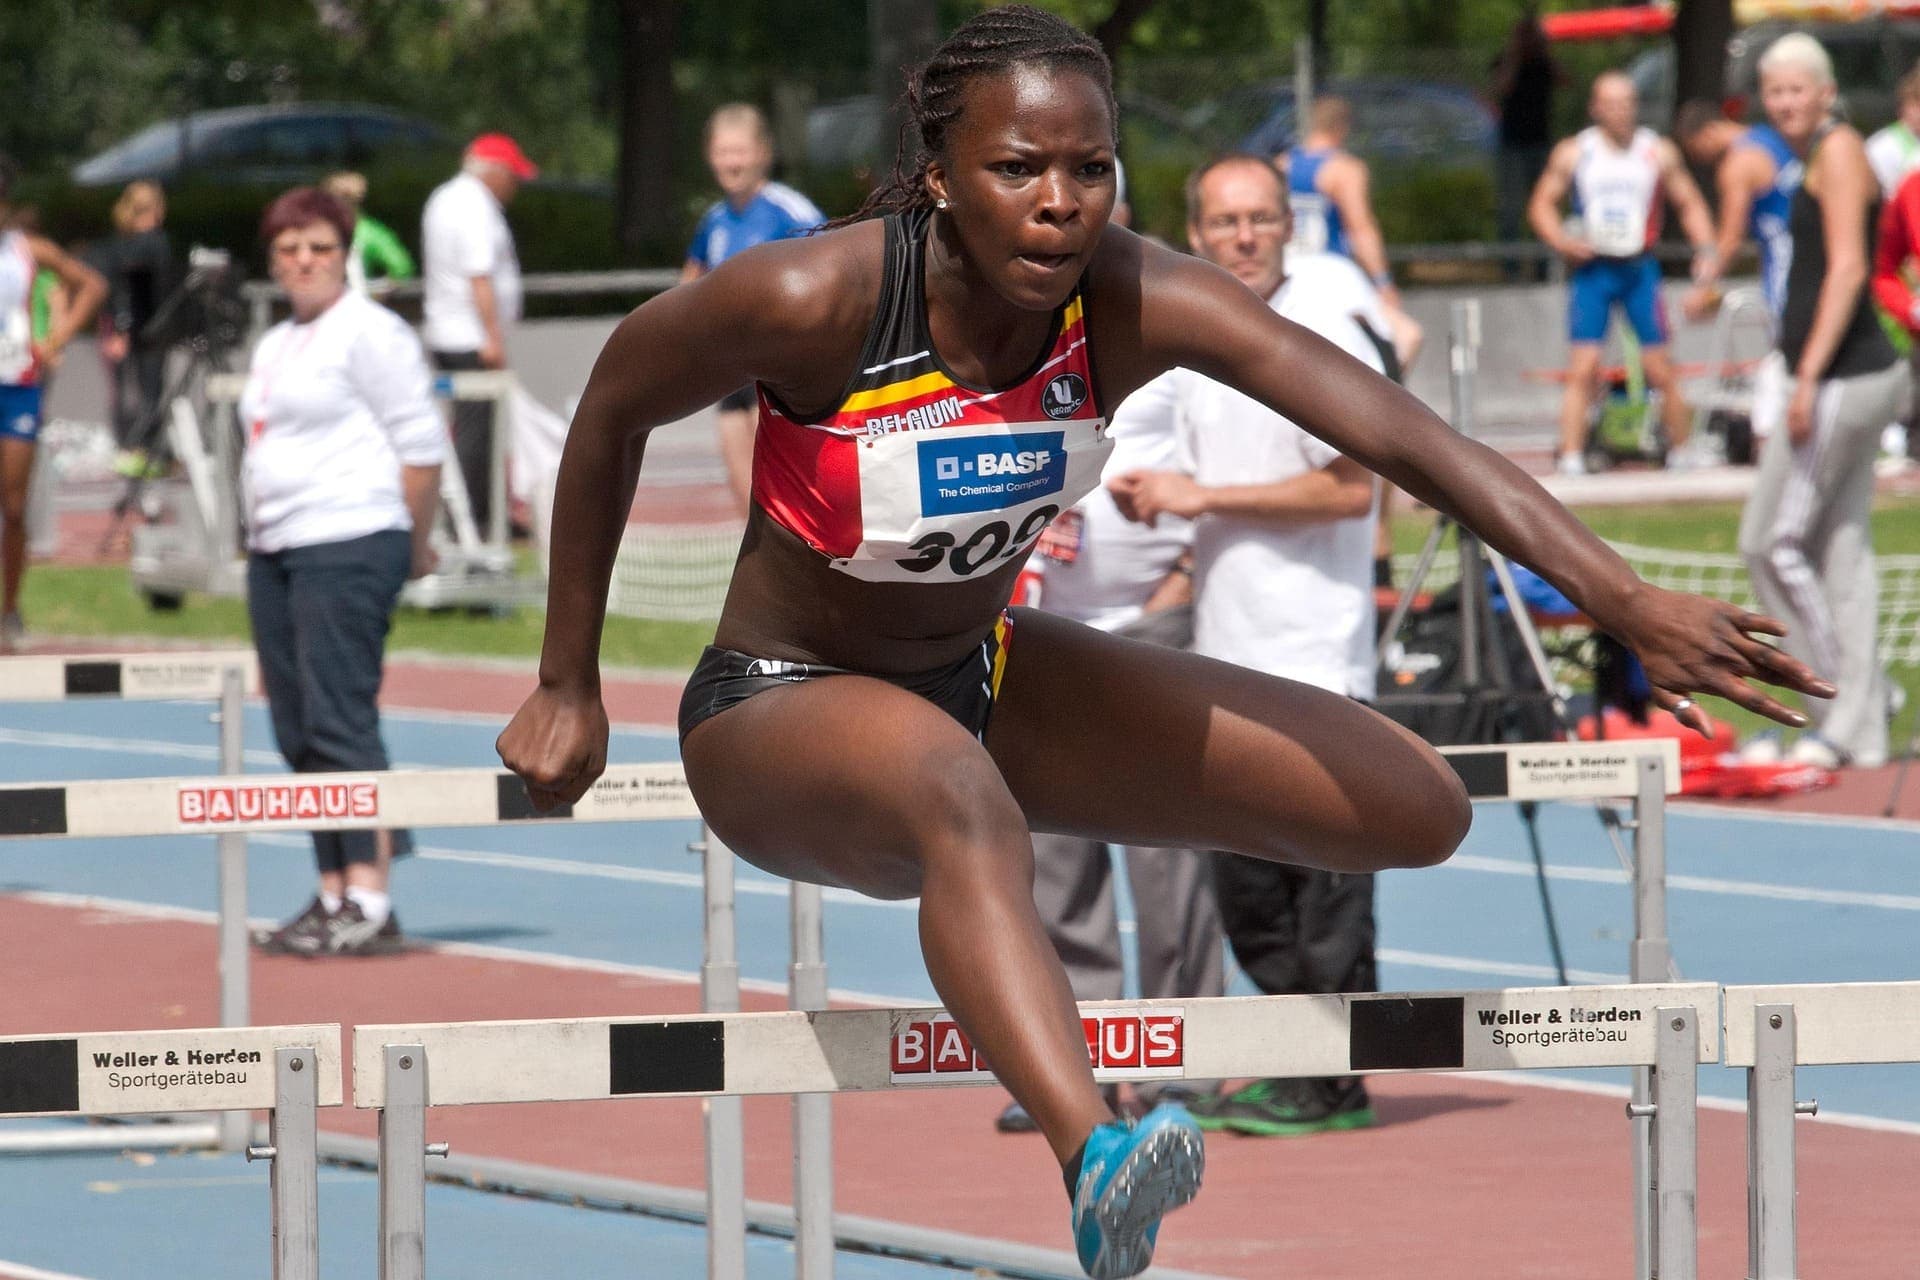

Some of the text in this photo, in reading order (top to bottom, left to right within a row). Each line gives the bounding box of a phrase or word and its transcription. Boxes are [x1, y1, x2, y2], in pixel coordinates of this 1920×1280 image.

[866, 396, 964, 437] BELGIUM
[977, 450, 1051, 476] BASF
[938, 476, 1050, 498] The Chemical Company
[182, 785, 376, 820] BAUHAUS
[1478, 1006, 1641, 1026] Weller & Herden
[898, 1020, 1179, 1066] BAUS
[1492, 1027, 1627, 1048] Sportgerätebau
[93, 1048, 261, 1068] Weller & Herden
[108, 1069, 247, 1091] Sportgerätebau
